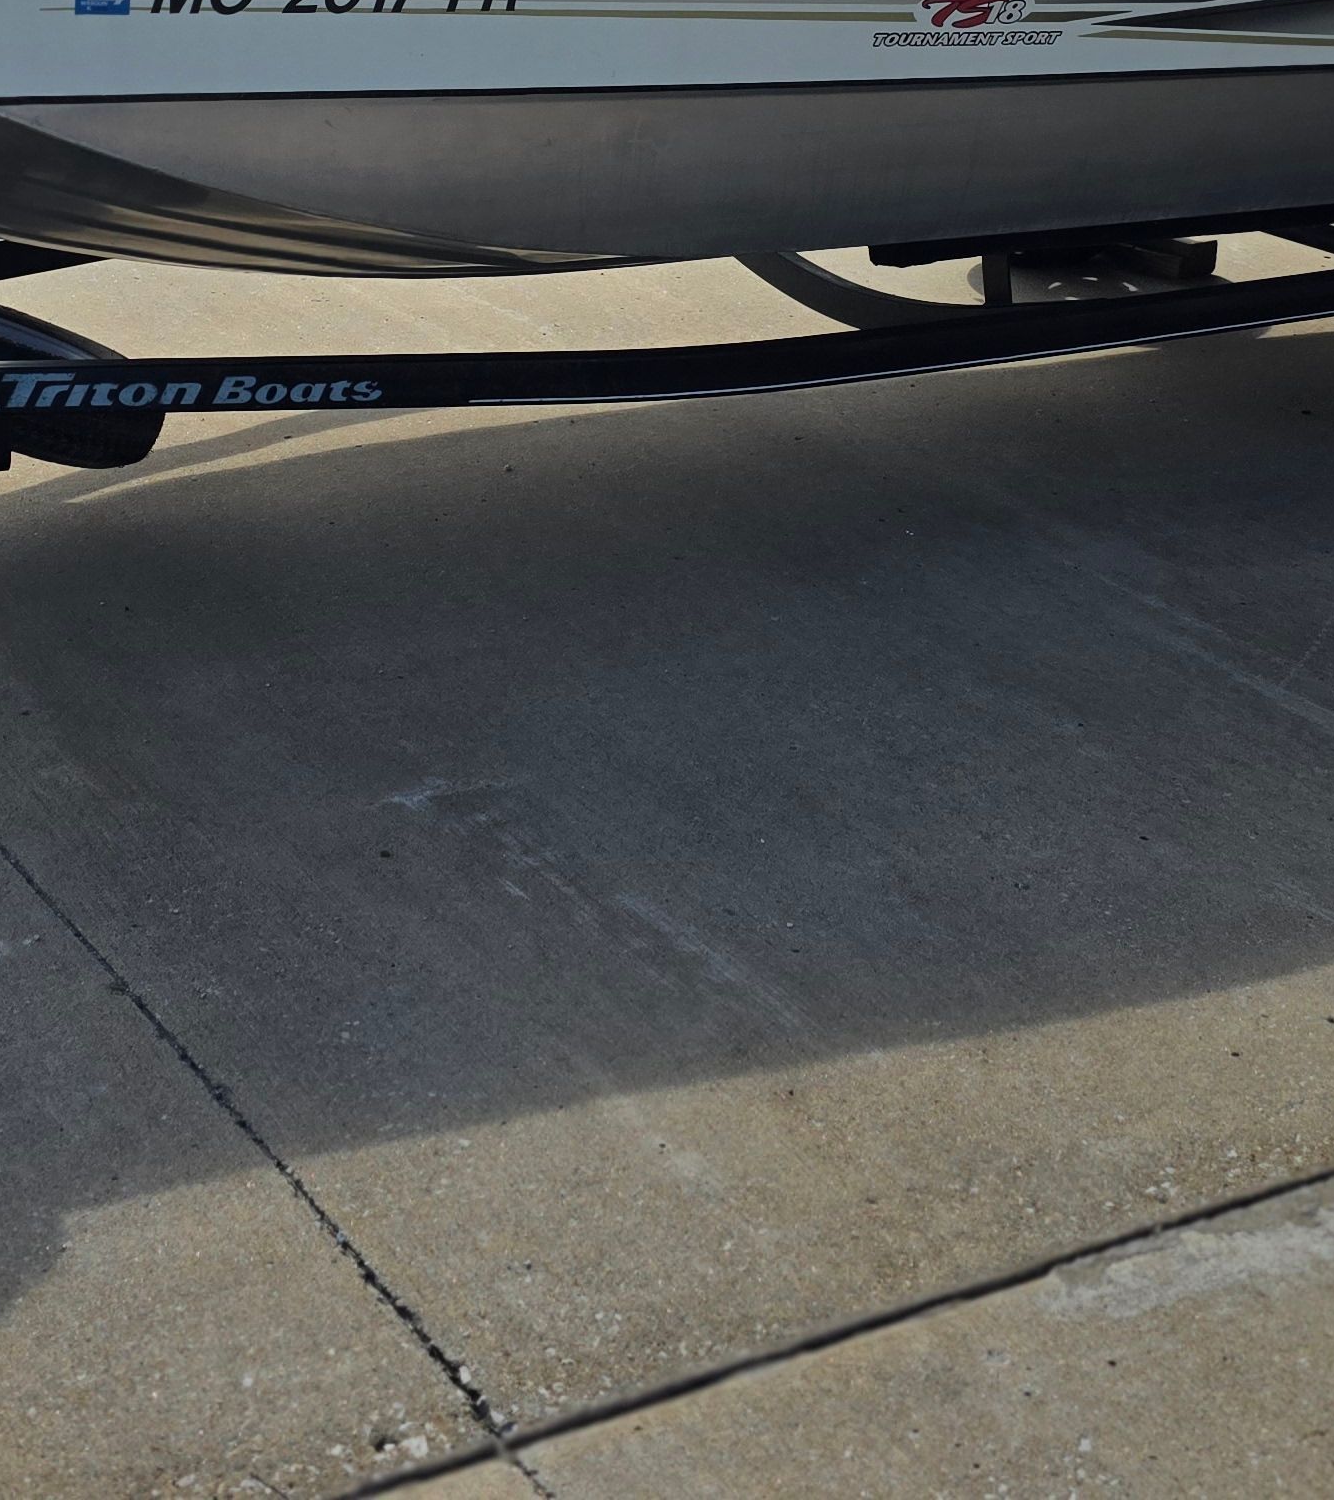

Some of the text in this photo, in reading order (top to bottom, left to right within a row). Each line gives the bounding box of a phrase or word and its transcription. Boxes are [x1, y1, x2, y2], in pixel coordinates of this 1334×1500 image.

[873, 30, 1063, 48] TOURNAMENT SPORT
[1, 372, 383, 408] Triton Boats
